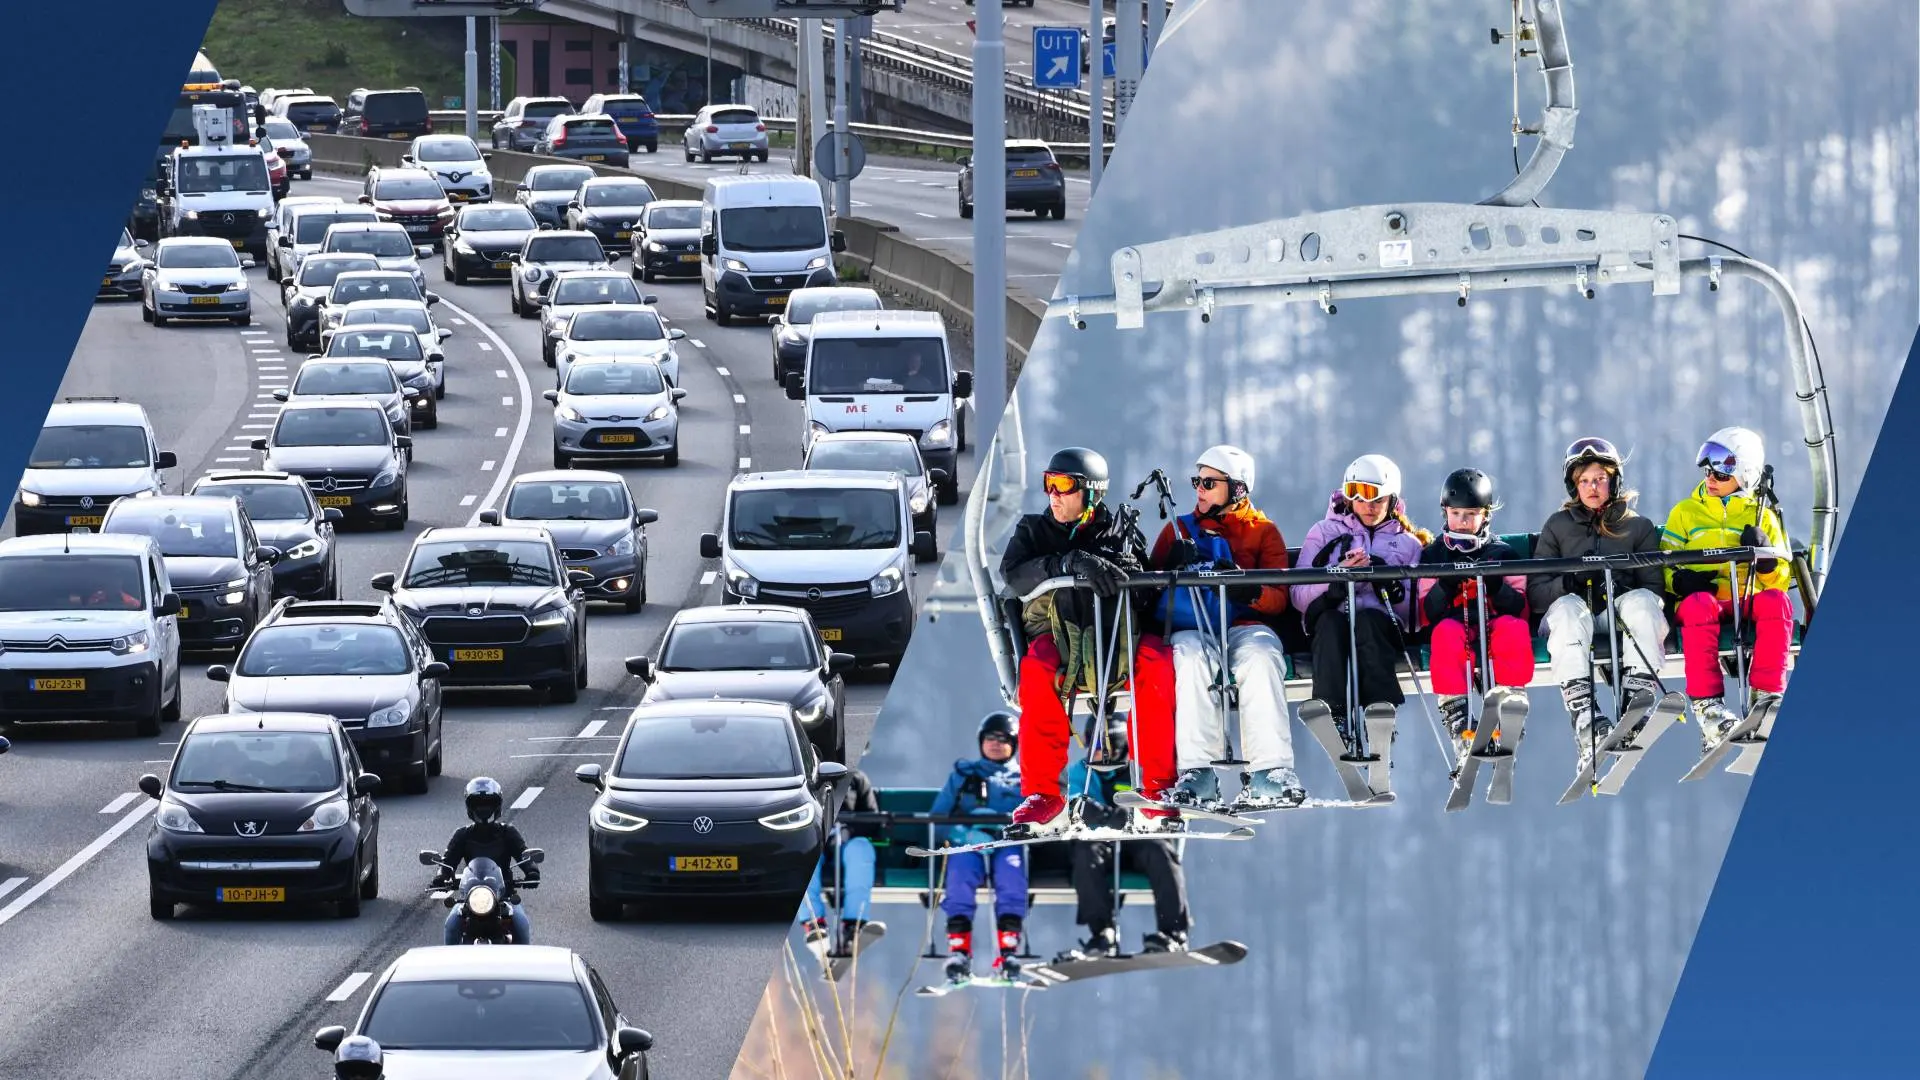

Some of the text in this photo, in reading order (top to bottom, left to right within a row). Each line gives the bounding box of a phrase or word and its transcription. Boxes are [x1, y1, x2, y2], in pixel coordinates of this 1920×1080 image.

[1041, 35, 1073, 50] UIT
[456, 650, 500, 660] L-930-RS
[38, 680, 82, 689] VGJ-23-R
[680, 858, 732, 869] J-412-XG
[227, 889, 279, 900] 10-PJH-9
